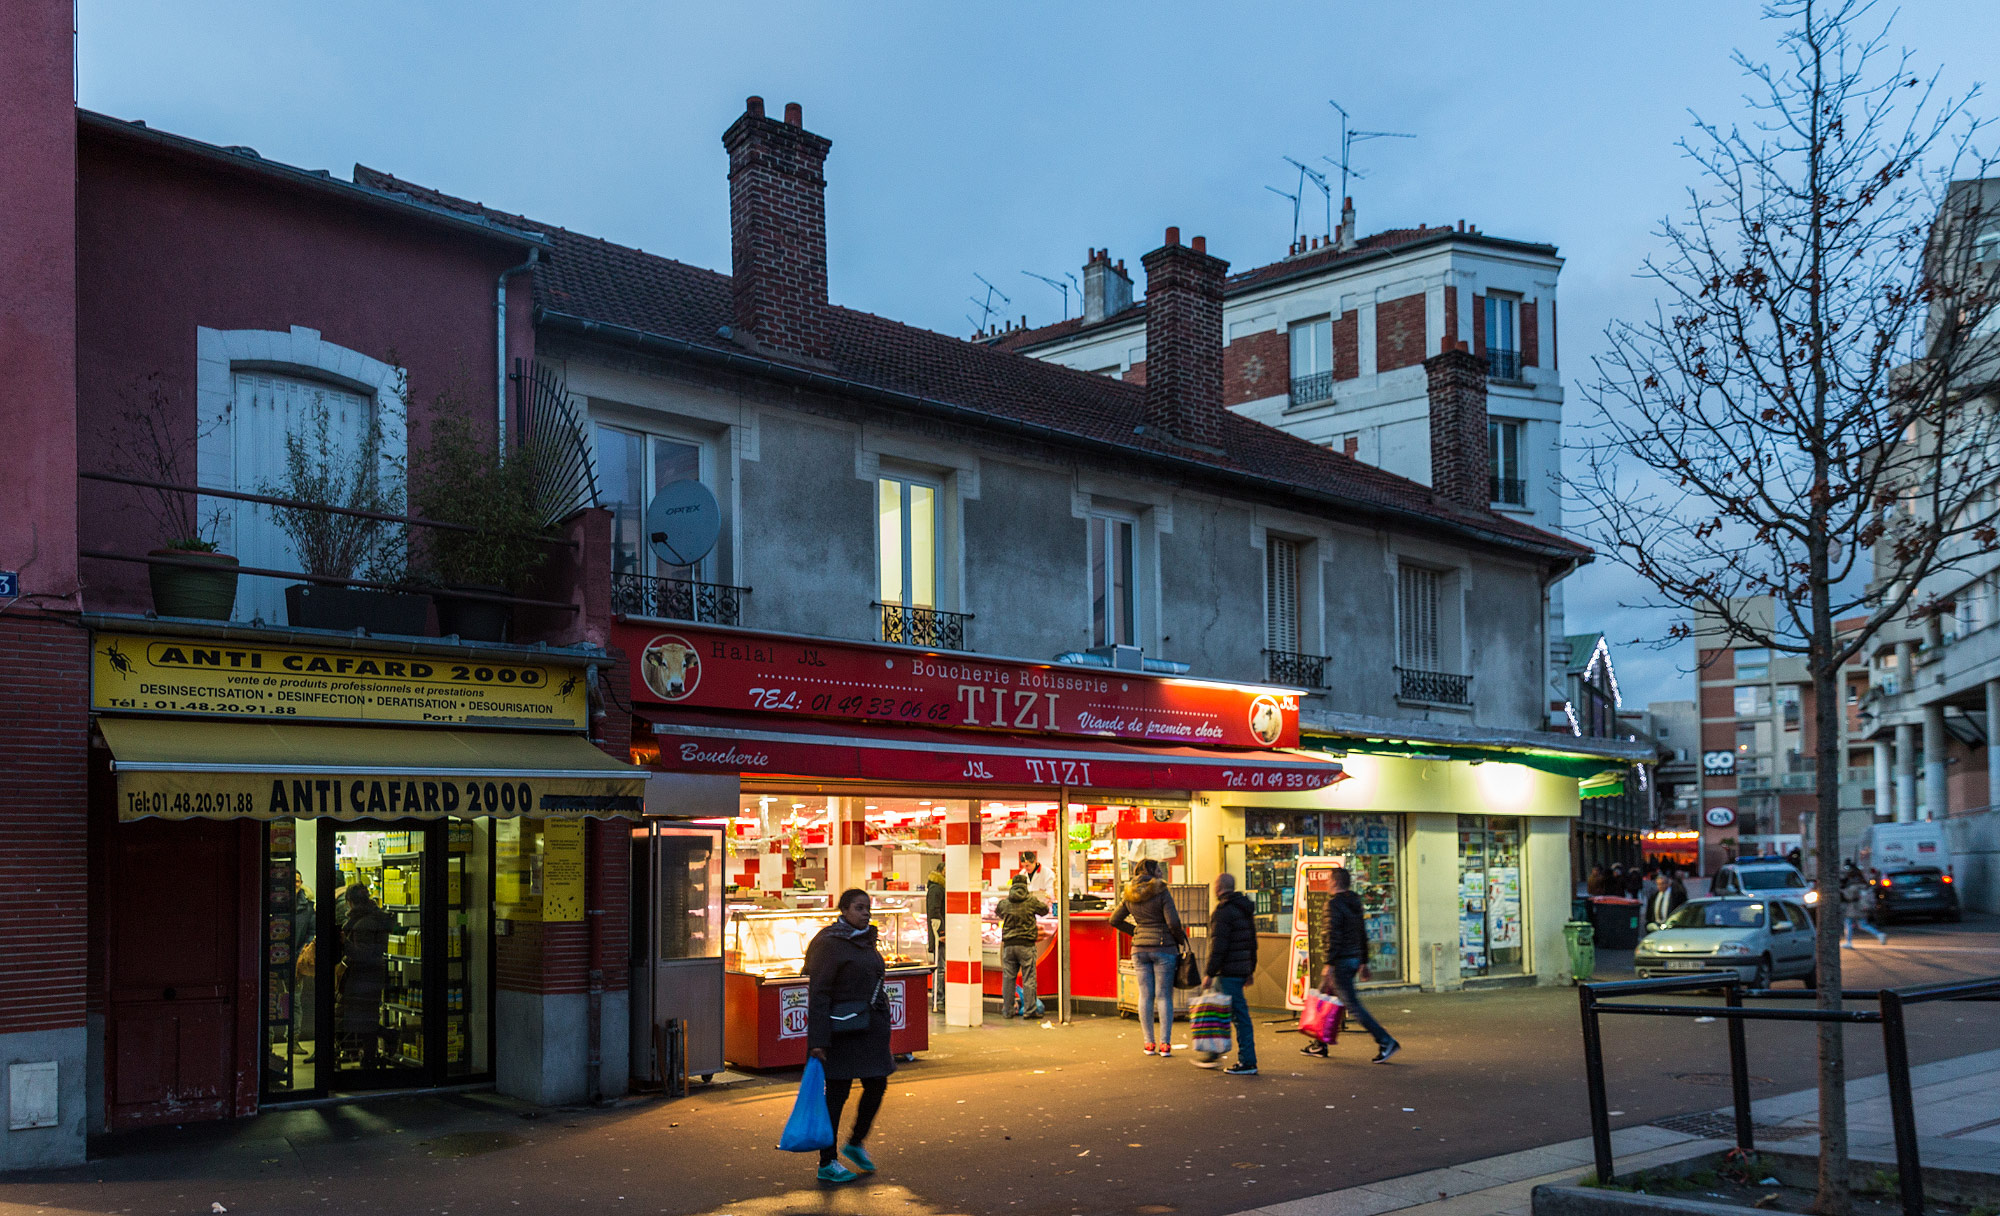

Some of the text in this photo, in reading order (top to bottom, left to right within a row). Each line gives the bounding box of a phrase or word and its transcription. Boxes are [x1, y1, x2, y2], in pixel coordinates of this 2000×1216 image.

[710, 641, 774, 663] Halal
[158, 647, 540, 685] ANTI CAFARD 2000
[911, 659, 1109, 693] Boucherie Rotisserie
[139, 683, 554, 714] DESINSECTISATION DESINFECTION DERATISATION DESOURISATION
[227, 675, 485, 698] vente de produits professionnels et prestations
[154, 700, 297, 715] 01.48.20.91.88
[748, 687, 950, 721] TEL: 01 49 33 06 62
[957, 684, 1061, 731] TIZI
[422, 712, 454, 722] Port
[1077, 711, 1224, 738] Viande de premier choix
[679, 742, 769, 766] Boucherie
[1704, 751, 1735, 769] GO
[962, 760, 994, 779] حلال
[1025, 759, 1093, 787] TIZI
[1222, 770, 1248, 787] Tel:
[1251, 773, 1264, 787] 01
[1267, 773, 1283, 787] 49
[1286, 773, 1304, 787] 33
[1306, 773, 1321, 787] 06
[268, 779, 343, 813] ANTI
[350, 779, 460, 813] CAFARD
[466, 781, 533, 813] 2000
